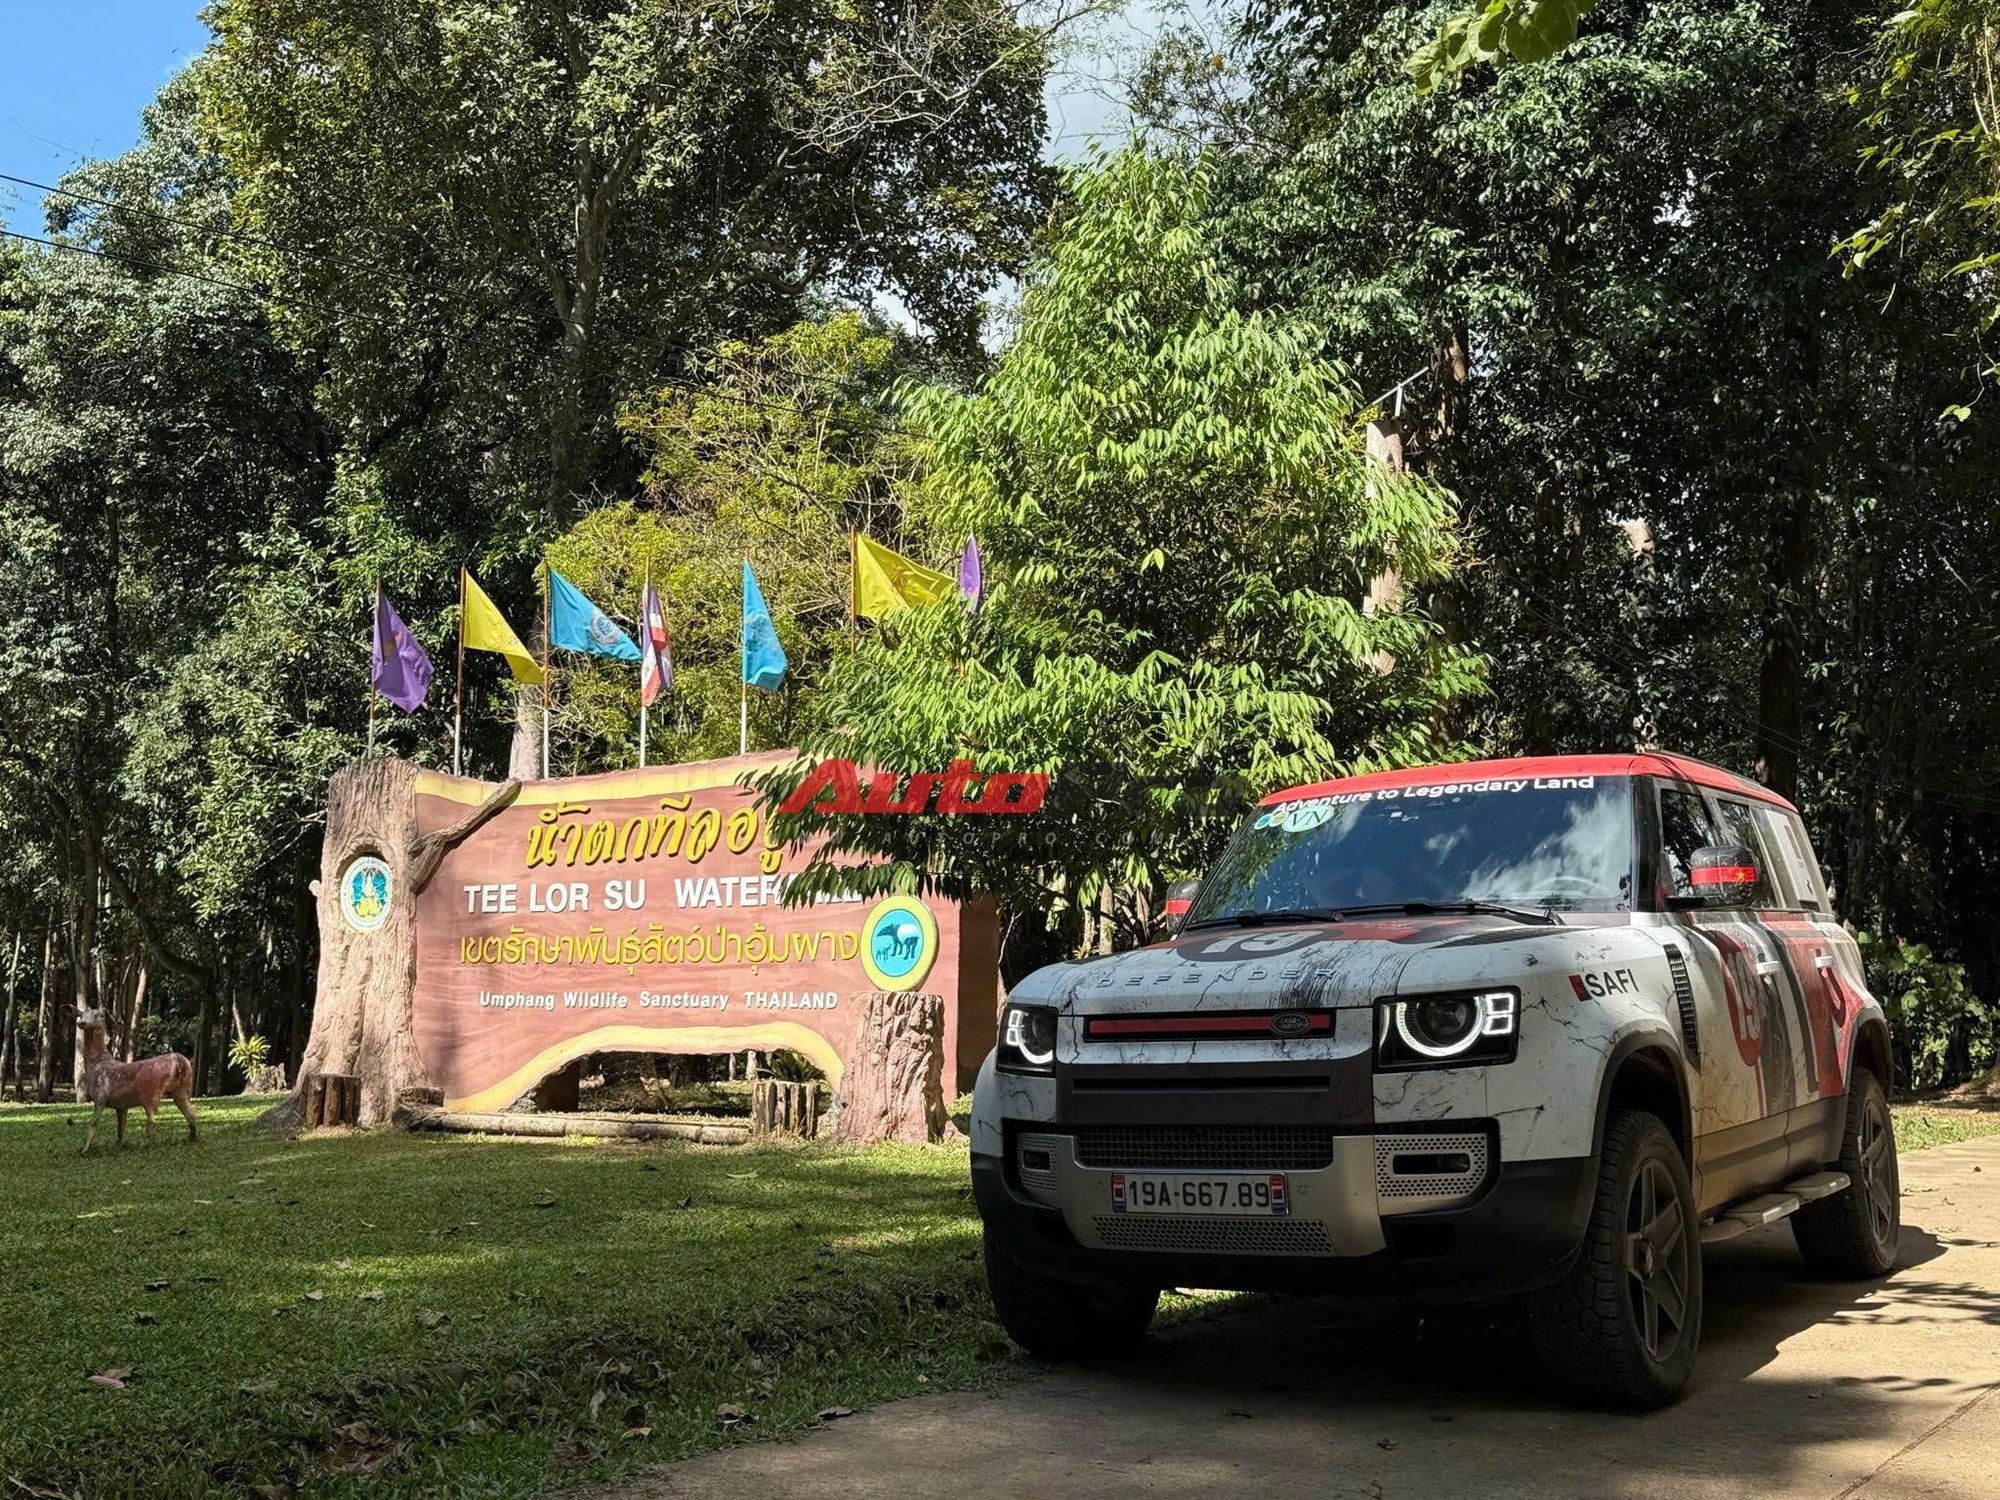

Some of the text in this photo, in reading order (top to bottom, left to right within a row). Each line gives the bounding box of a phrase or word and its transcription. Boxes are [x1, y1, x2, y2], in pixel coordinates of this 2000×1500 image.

[1272, 775, 1595, 814] Adventure to Legendary Land
[1291, 810, 1329, 827] VN
[464, 872, 863, 914] TEE LOR SU WATER
[460, 923, 859, 975] เขตรักษาพันธุ์สัตว์ป่าอุ้มผาง
[1095, 966, 1336, 989] DEFENDER
[1584, 968, 1639, 998] SAFI
[480, 990, 839, 1011] Umphang Wildlife Sanctuary THAILAND
[1129, 1181, 1271, 1208] 19A-667.89
